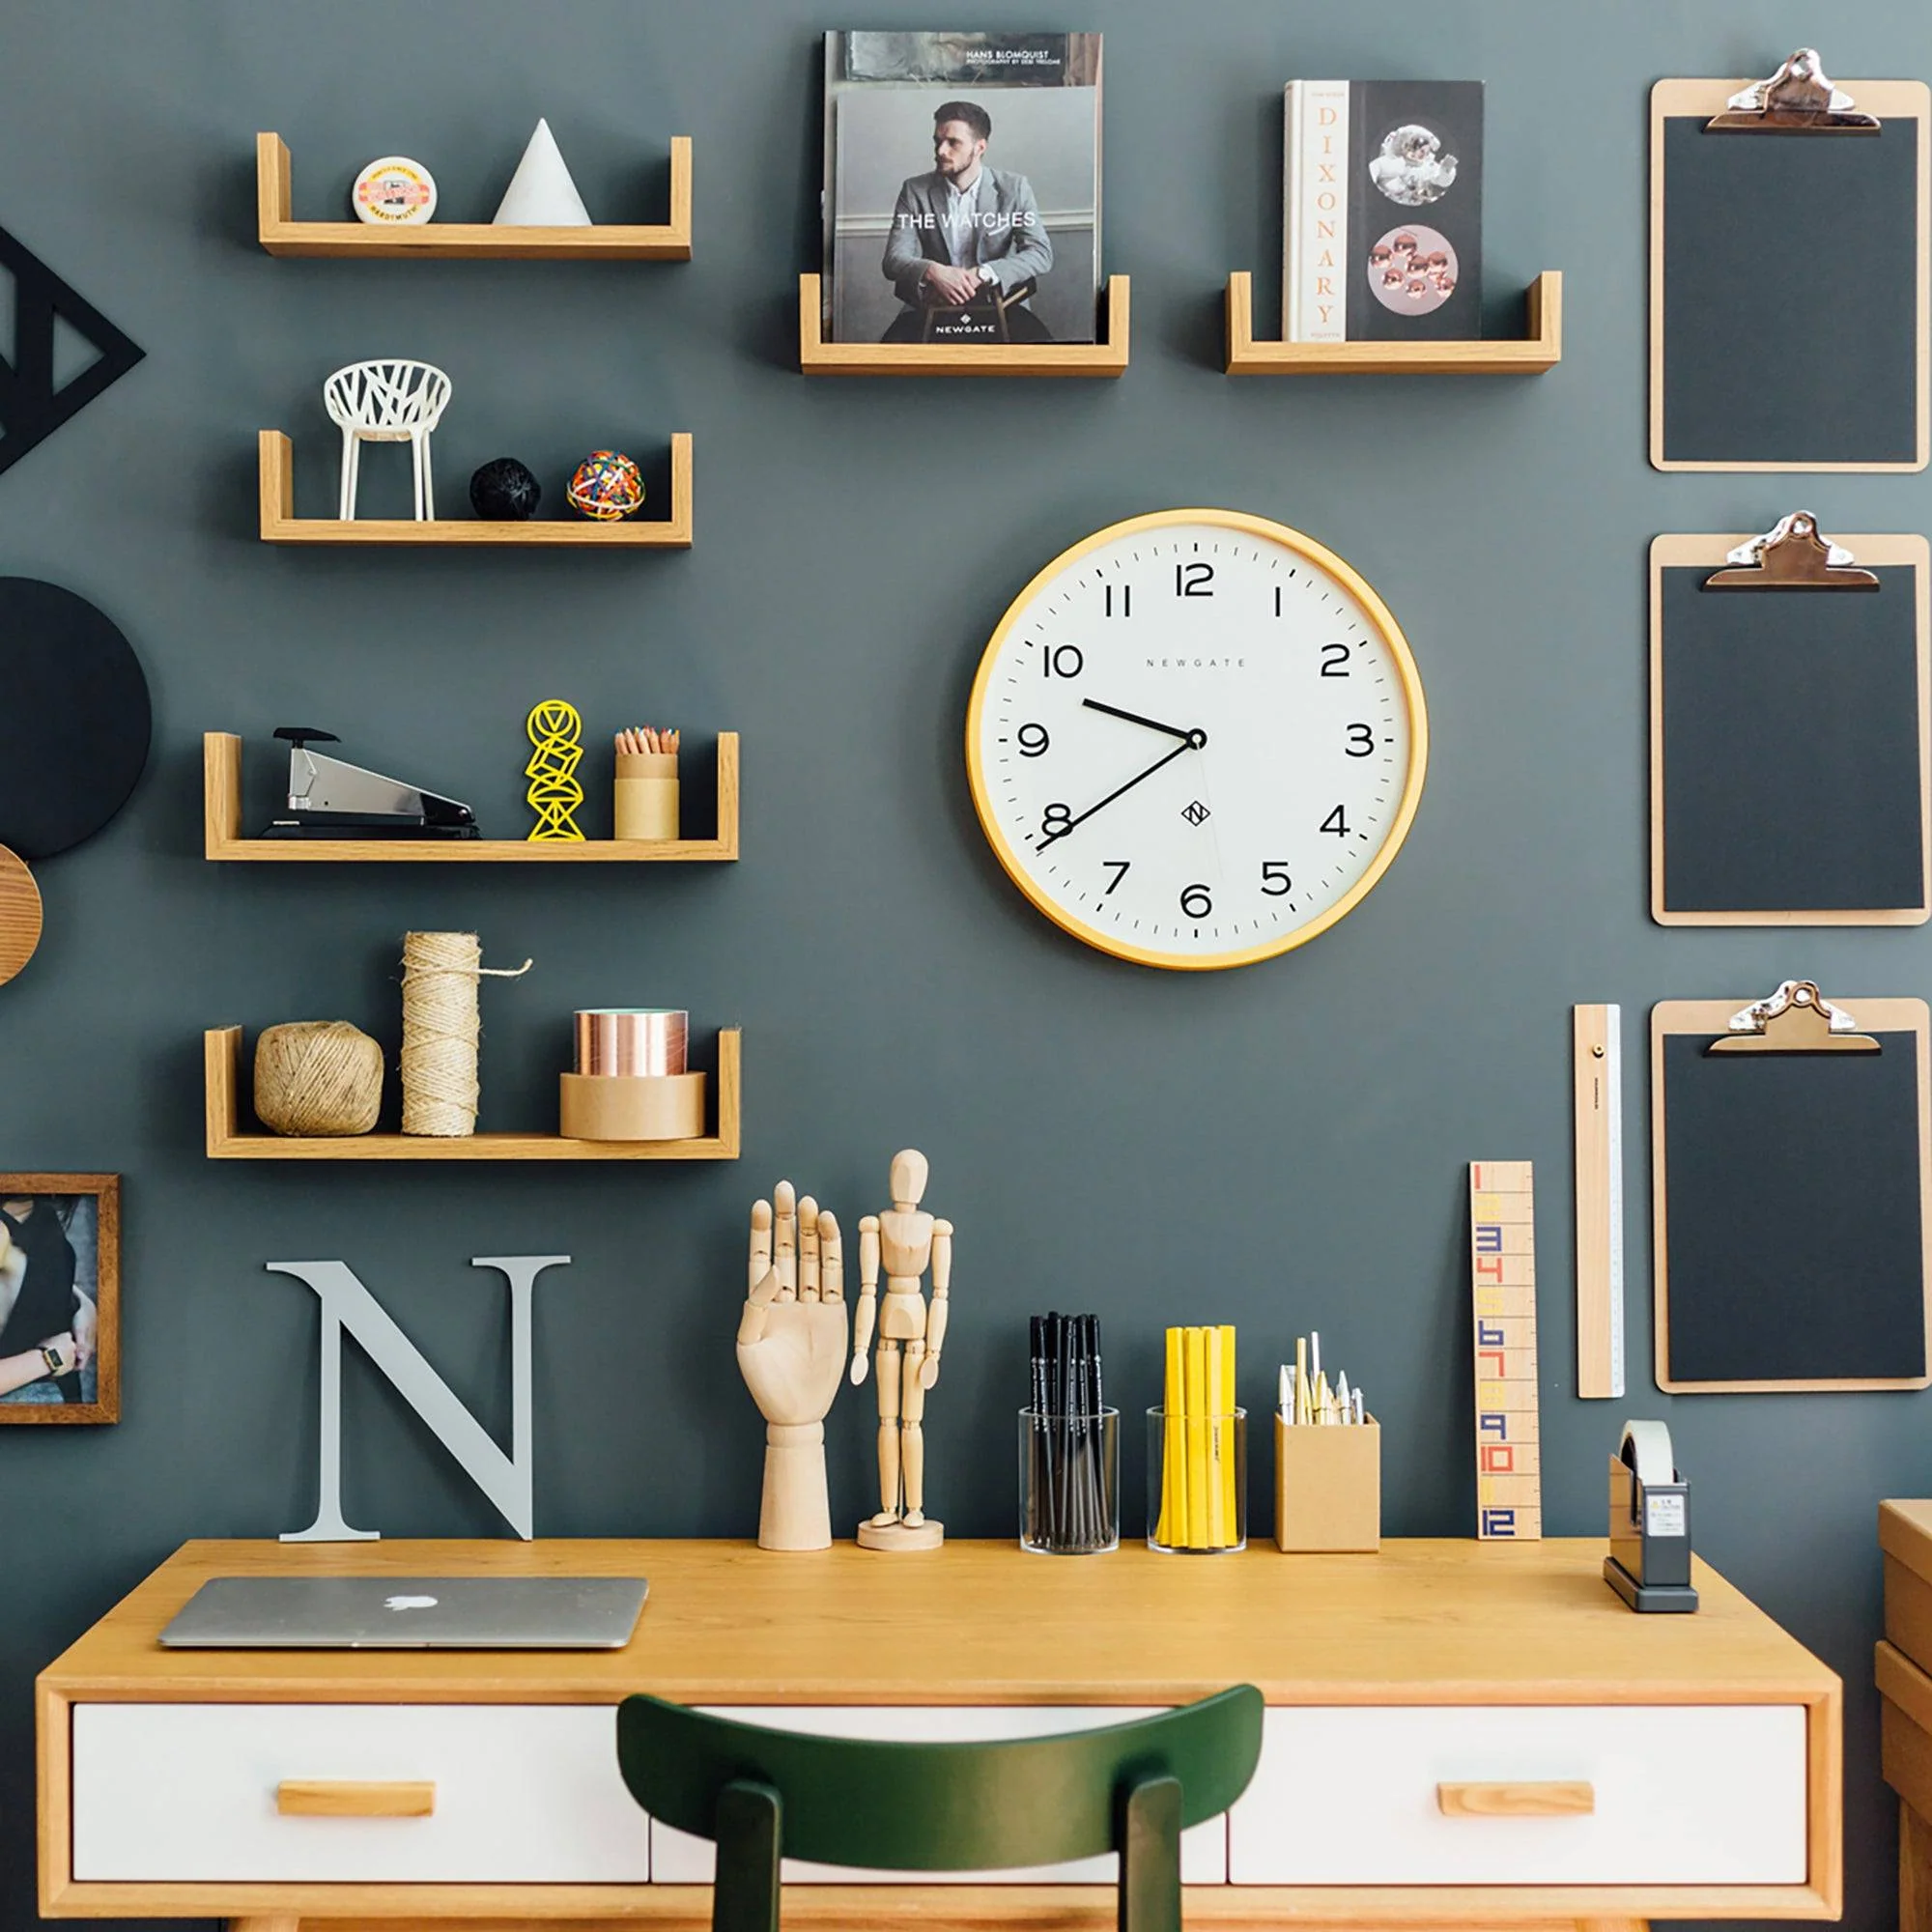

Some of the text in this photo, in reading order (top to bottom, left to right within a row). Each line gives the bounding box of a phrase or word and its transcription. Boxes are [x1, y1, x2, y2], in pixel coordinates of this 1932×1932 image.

[966, 50, 1049, 59] HANS BLOMQUIST
[897, 212, 1036, 229] THE WATCHES
[1318, 107, 1337, 324] DIXONARY
[936, 325, 996, 334] NEWGATE
[1177, 563, 1214, 596] 12
[1105, 585, 1130, 617] 11
[1275, 586, 1281, 617] 1
[1044, 645, 1083, 678] 10
[1147, 658, 1244, 668] NEWGATE
[1321, 643, 1350, 676] 2
[1017, 724, 1049, 757] 9
[1345, 724, 1375, 757] 3
[1041, 804, 1073, 838] 8
[1320, 805, 1350, 838] 4
[1102, 862, 1130, 895] 7
[1262, 862, 1293, 896] 5
[1180, 884, 1212, 919] 6
[1475, 1195, 1500, 1221] 2
[1476, 1227, 1501, 1252] 3
[1477, 1258, 1502, 1283] 4
[1477, 1288, 1503, 1315] 5
[1479, 1321, 1504, 1346] 6
[1479, 1352, 1504, 1377] 7
[266, 1255, 571, 1543] N
[1480, 1382, 1505, 1407] 8
[1481, 1415, 1506, 1440] 9
[1481, 1446, 1513, 1471] 10
[1483, 1510, 1516, 1536] 12
